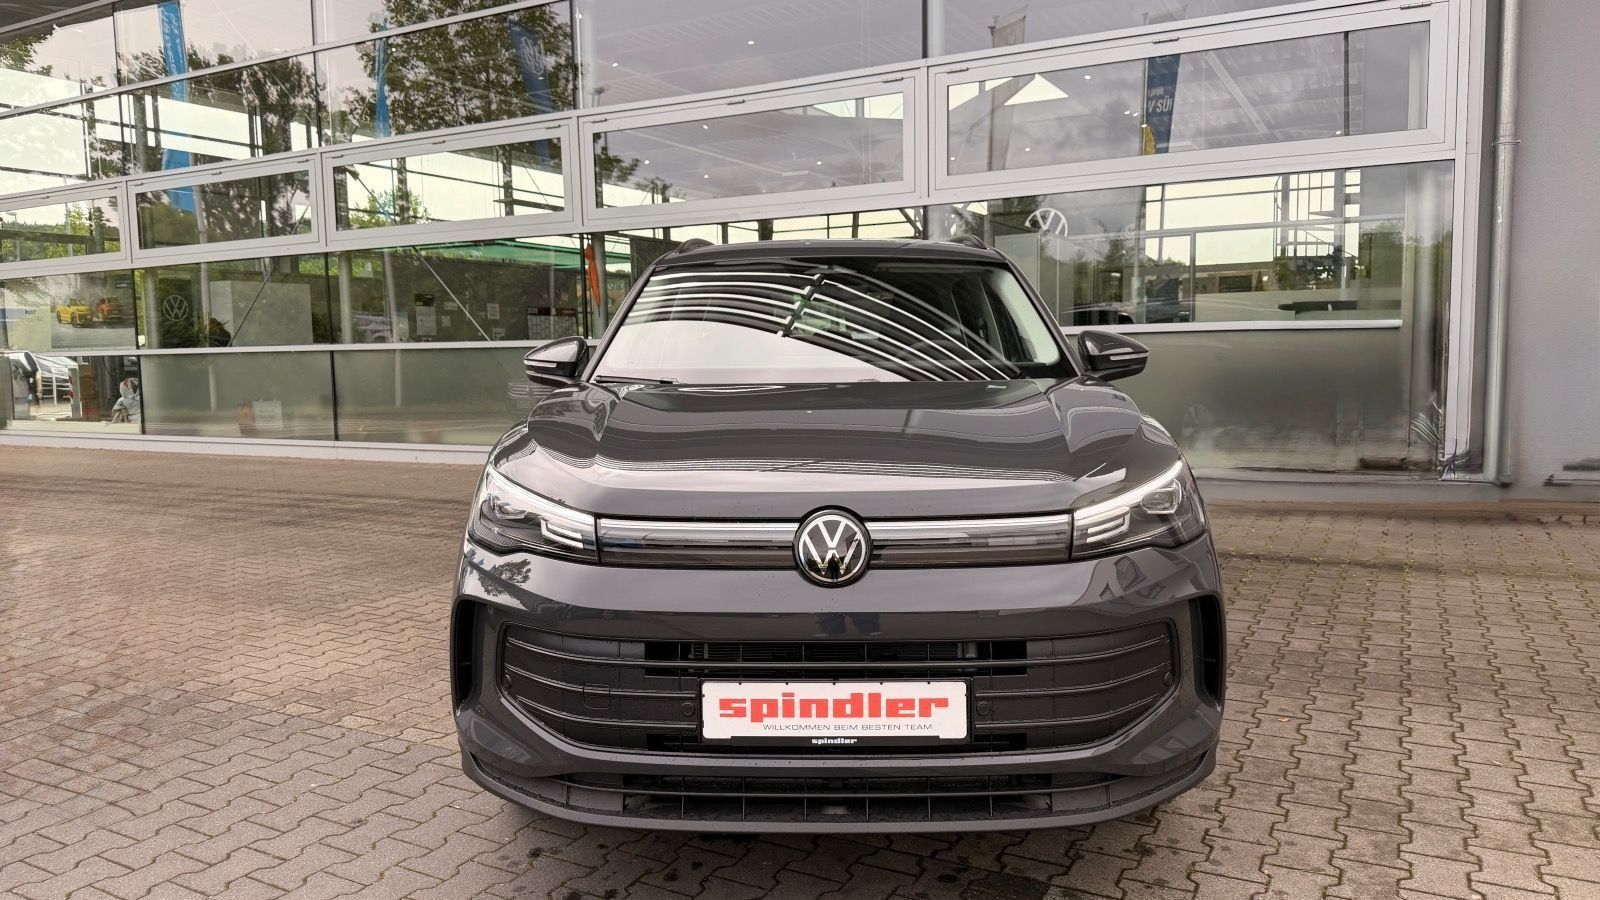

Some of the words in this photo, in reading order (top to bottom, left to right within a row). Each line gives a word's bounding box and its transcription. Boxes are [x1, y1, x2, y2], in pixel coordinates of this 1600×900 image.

[799, 514, 866, 582] VW
[719, 692, 949, 722] spindler
[811, 737, 858, 745] spindler
